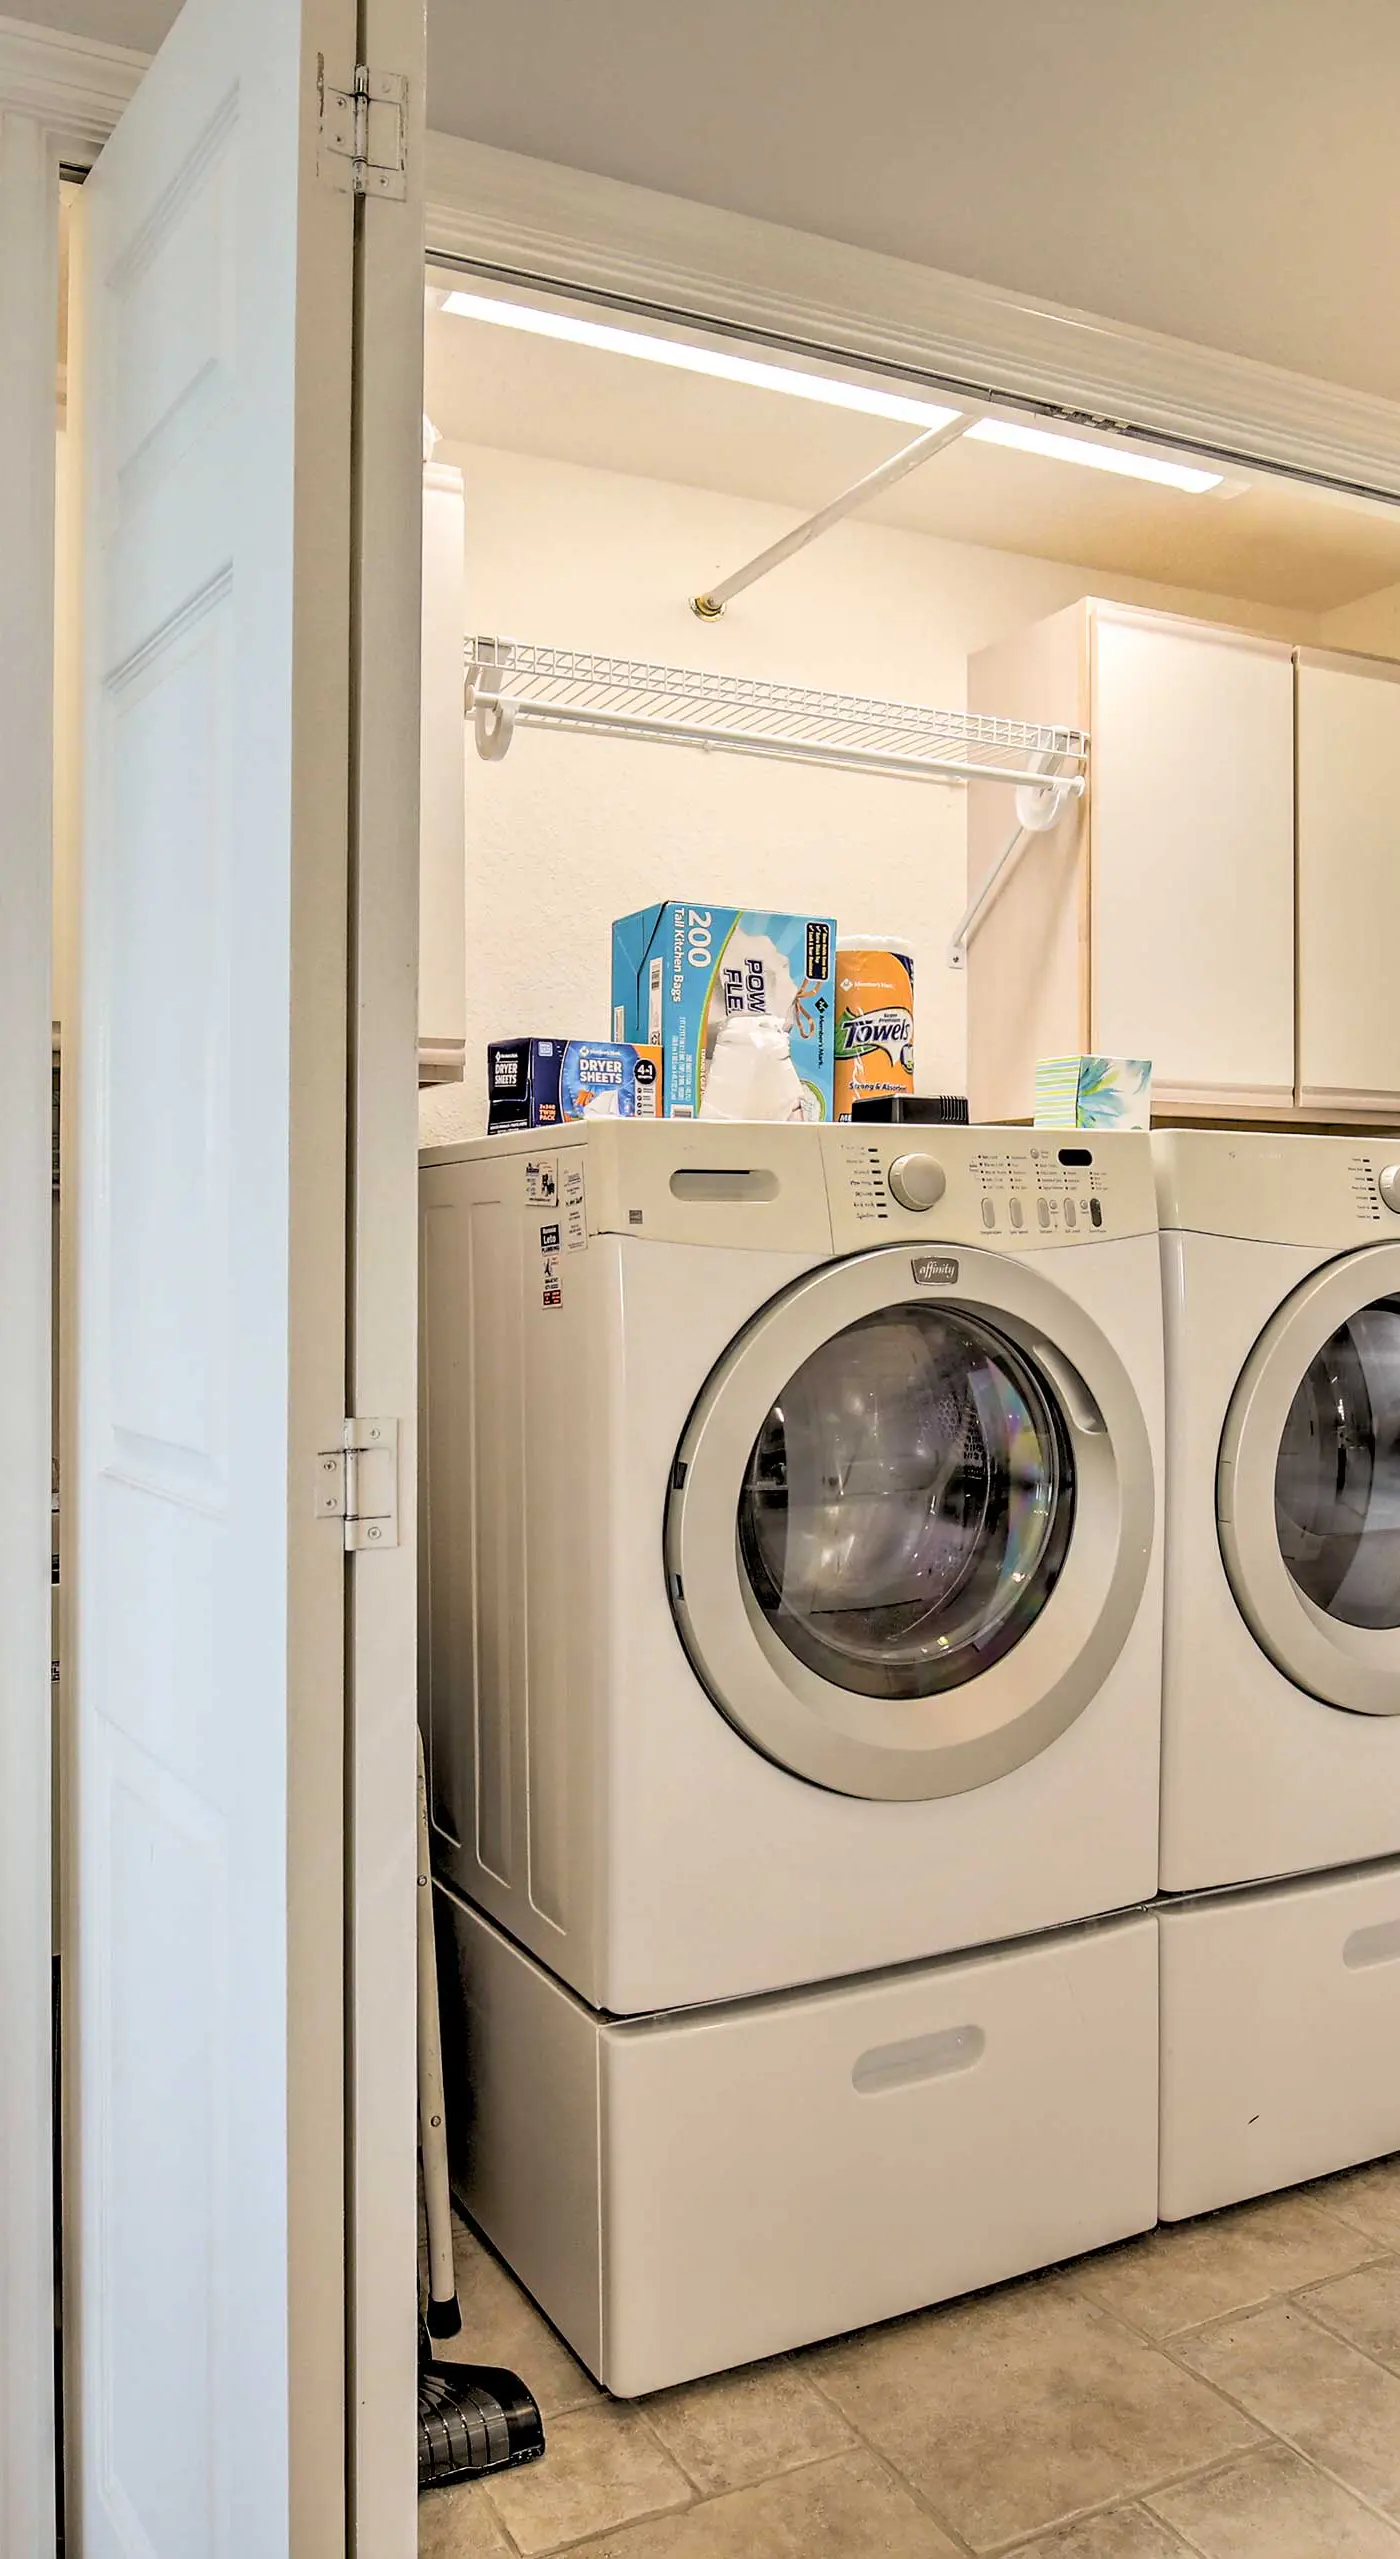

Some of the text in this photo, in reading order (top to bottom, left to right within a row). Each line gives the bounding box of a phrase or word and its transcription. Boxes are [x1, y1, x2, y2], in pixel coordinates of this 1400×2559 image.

[674, 907, 685, 928] Tall
[687, 909, 712, 968] 200
[673, 931, 685, 972] Kitchen
[670, 976, 684, 1003] Bags
[724, 968, 745, 1014] FLE
[745, 959, 766, 1014] POW
[842, 1018, 910, 1050] Towels
[494, 1063, 518, 1074] DRYER
[579, 1059, 622, 1073] DRYER
[579, 1072, 623, 1084] SHEETS
[494, 1074, 517, 1085] SHEETS
[919, 1261, 955, 1279] affinity
